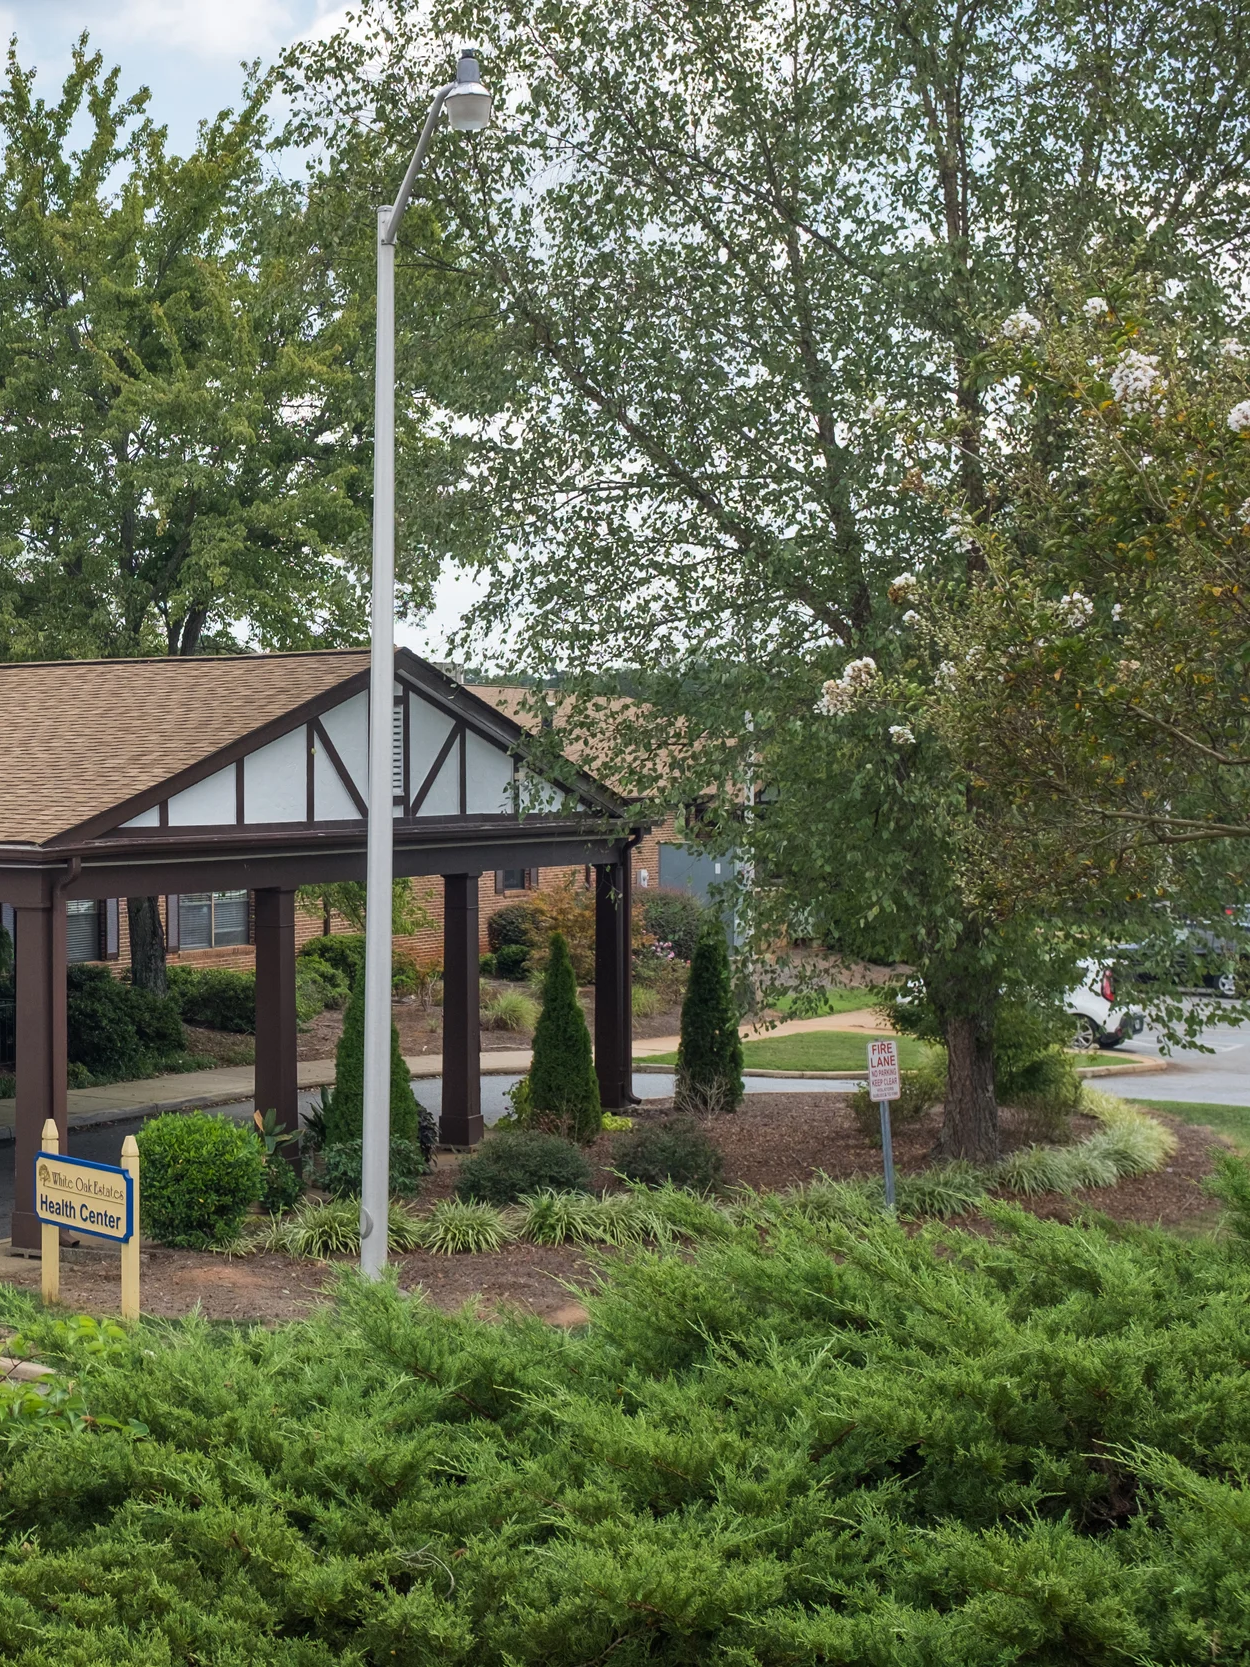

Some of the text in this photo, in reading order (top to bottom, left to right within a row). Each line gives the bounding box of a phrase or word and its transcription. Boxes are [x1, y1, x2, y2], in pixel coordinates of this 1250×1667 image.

[872, 1043, 892, 1055] FIRE
[870, 1055, 896, 1068] LANE
[871, 1068, 897, 1078] NO PARKING
[872, 1077, 897, 1087] KEEP CLEAR
[52, 1172, 124, 1200] White Oak Estates
[40, 1193, 121, 1230] Health Center
